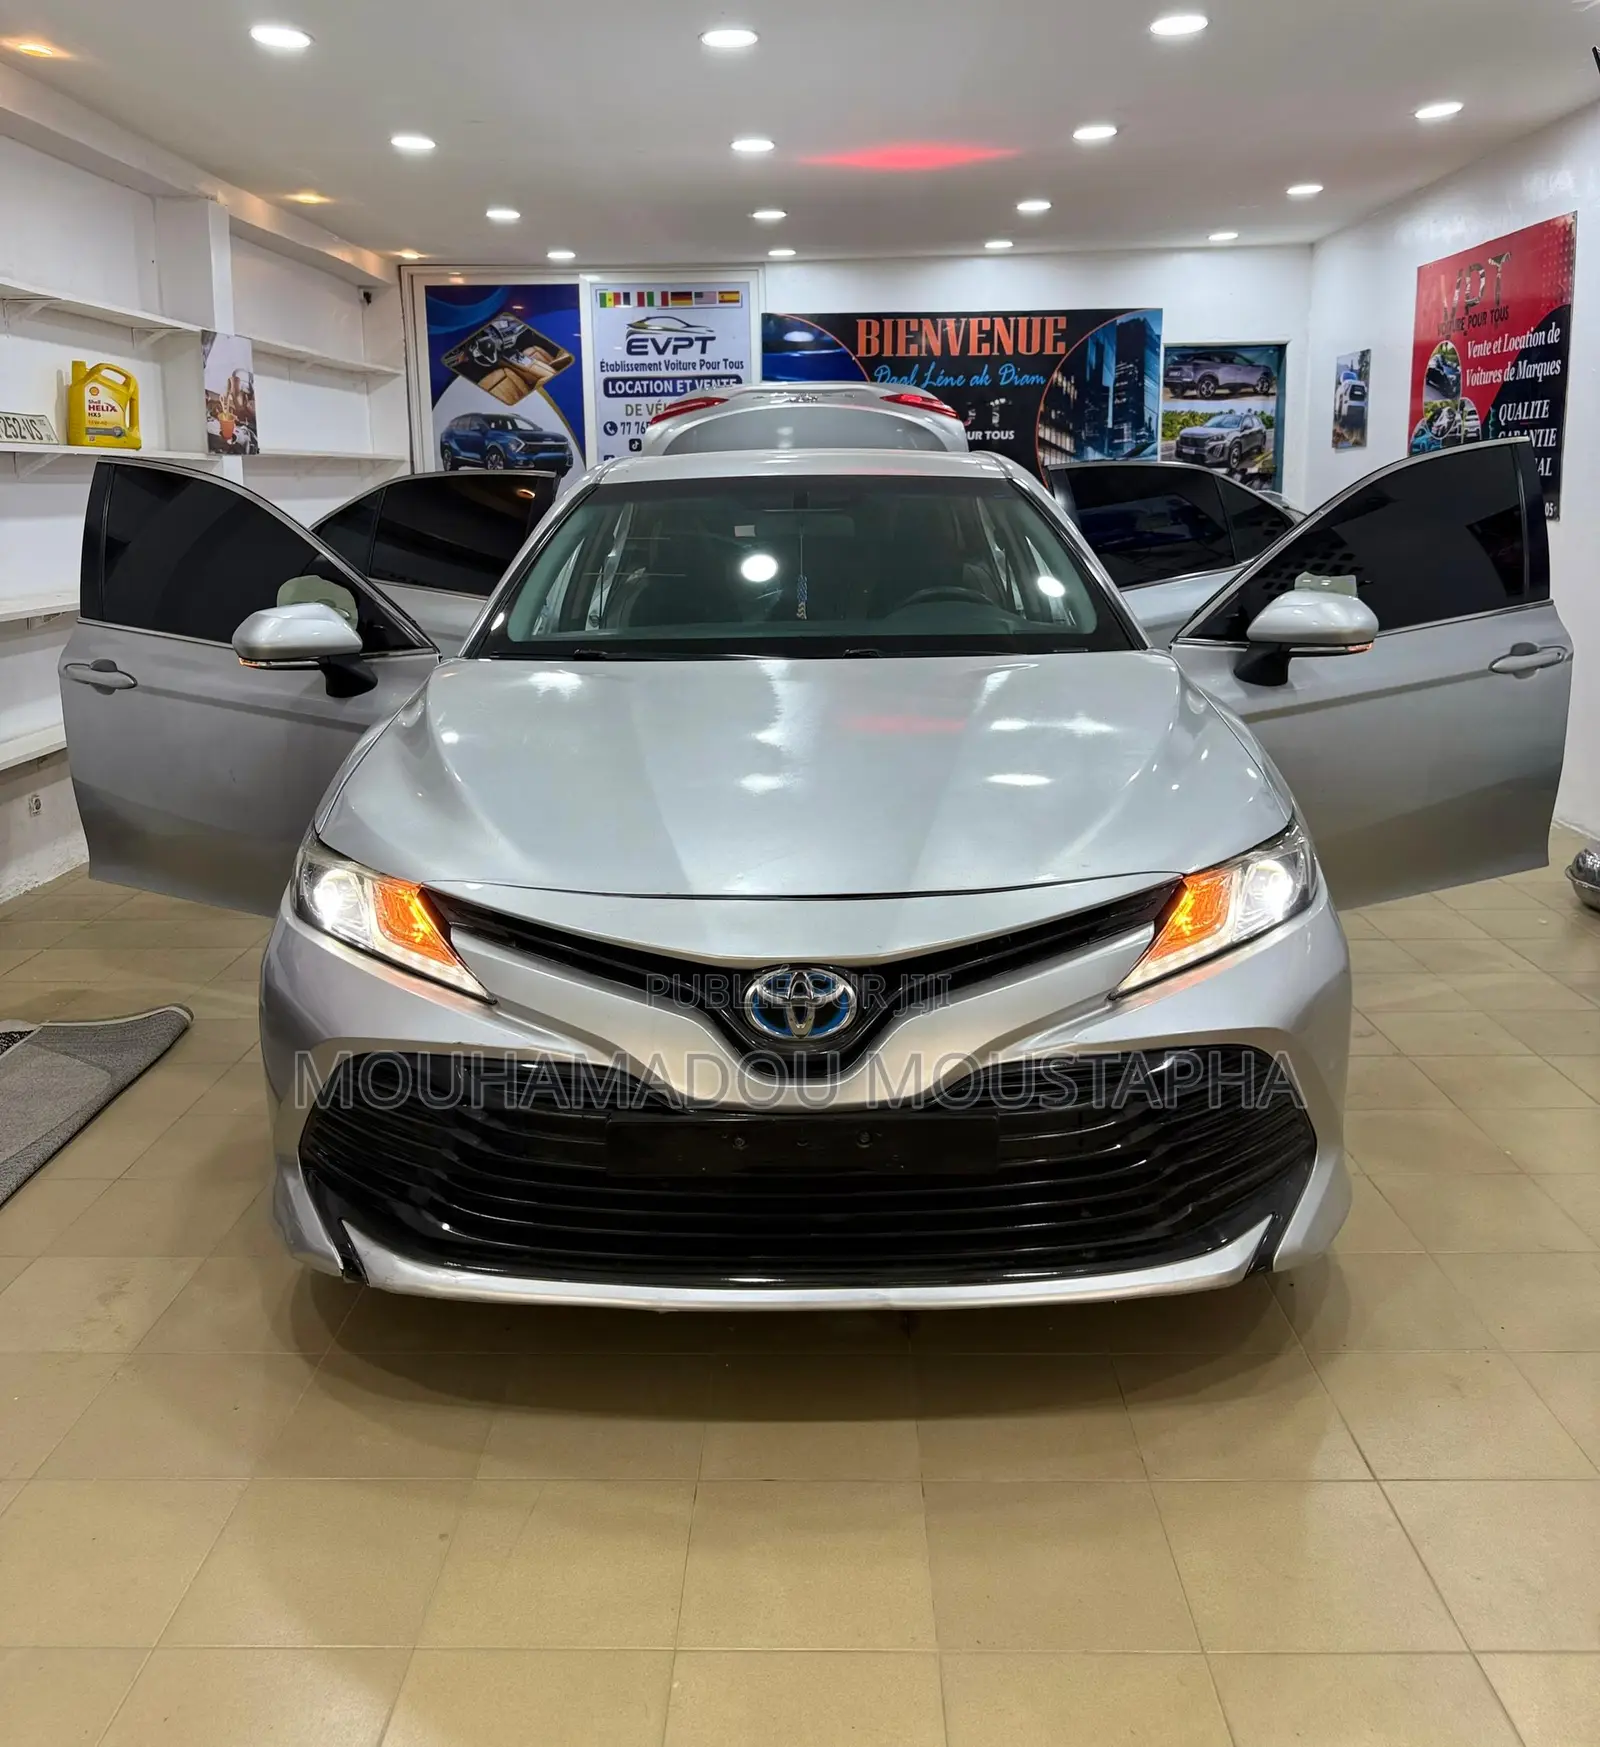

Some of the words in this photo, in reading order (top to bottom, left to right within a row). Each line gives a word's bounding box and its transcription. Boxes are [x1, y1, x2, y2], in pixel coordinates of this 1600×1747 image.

[1468, 311, 1488, 329] POUR
[1490, 306, 1510, 323] TOUS
[856, 316, 1067, 358] BIENVENUE
[1467, 339, 1492, 359] Vente
[1492, 337, 1503, 353] et
[1503, 326, 1546, 353] Location
[1547, 321, 1561, 344] de
[625, 336, 717, 356] EVPT
[600, 358, 663, 373] Établissement
[664, 359, 698, 372] Voiture
[699, 358, 722, 371] Pour
[722, 358, 745, 371] Tous
[1466, 365, 1502, 387] Voitures
[1503, 361, 1516, 382] de
[1515, 359, 1562, 382] Marques
[608, 380, 673, 394] LOCATION
[676, 380, 693, 393] ET
[88, 402, 118, 412] HELIX
[625, 404, 643, 417] DE
[1498, 400, 1550, 426] QUALITE
[620, 421, 632, 435] 77
[984, 430, 1015, 441] TOUS
